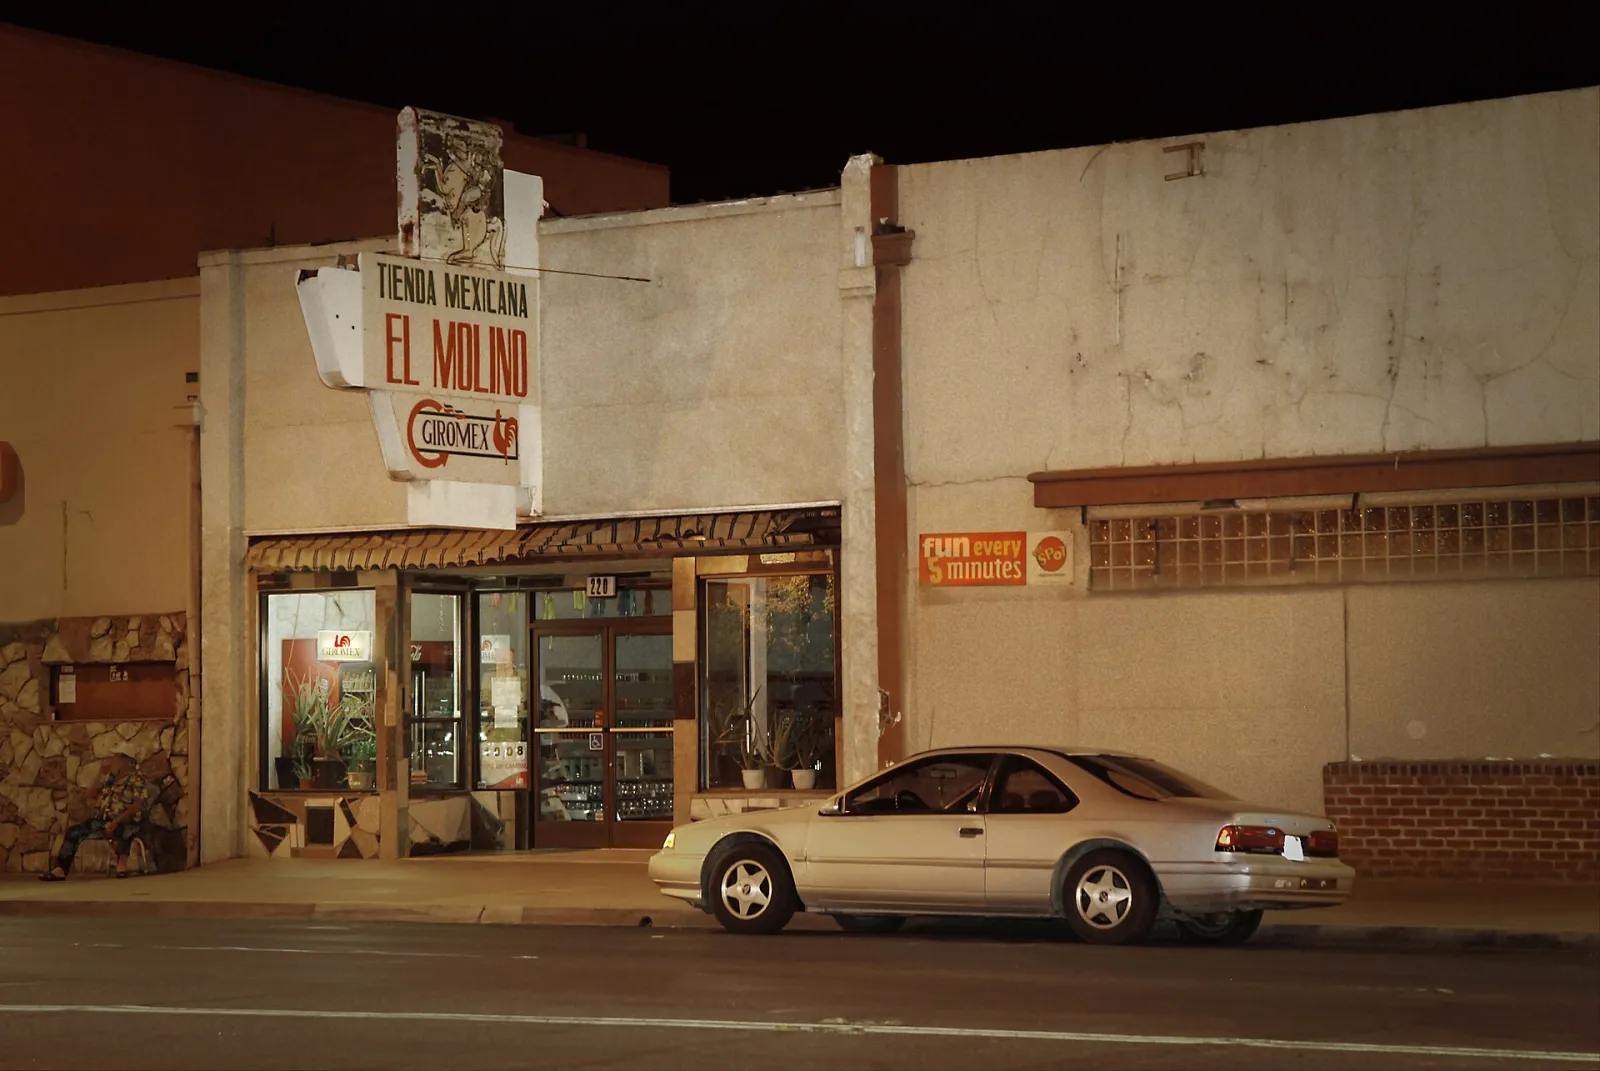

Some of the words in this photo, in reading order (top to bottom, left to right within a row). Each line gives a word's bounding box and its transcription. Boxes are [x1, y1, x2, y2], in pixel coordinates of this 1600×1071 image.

[377, 262, 437, 306] TIENDA
[444, 272, 528, 319] MEXICANA
[385, 313, 420, 386] EL
[432, 319, 528, 398] MOLINO
[422, 419, 490, 451] GIROMEX
[922, 536, 970, 558] fun
[973, 539, 1022, 559] every
[927, 556, 943, 584] 5
[947, 559, 1022, 580] minutes
[590, 577, 608, 595] 220
